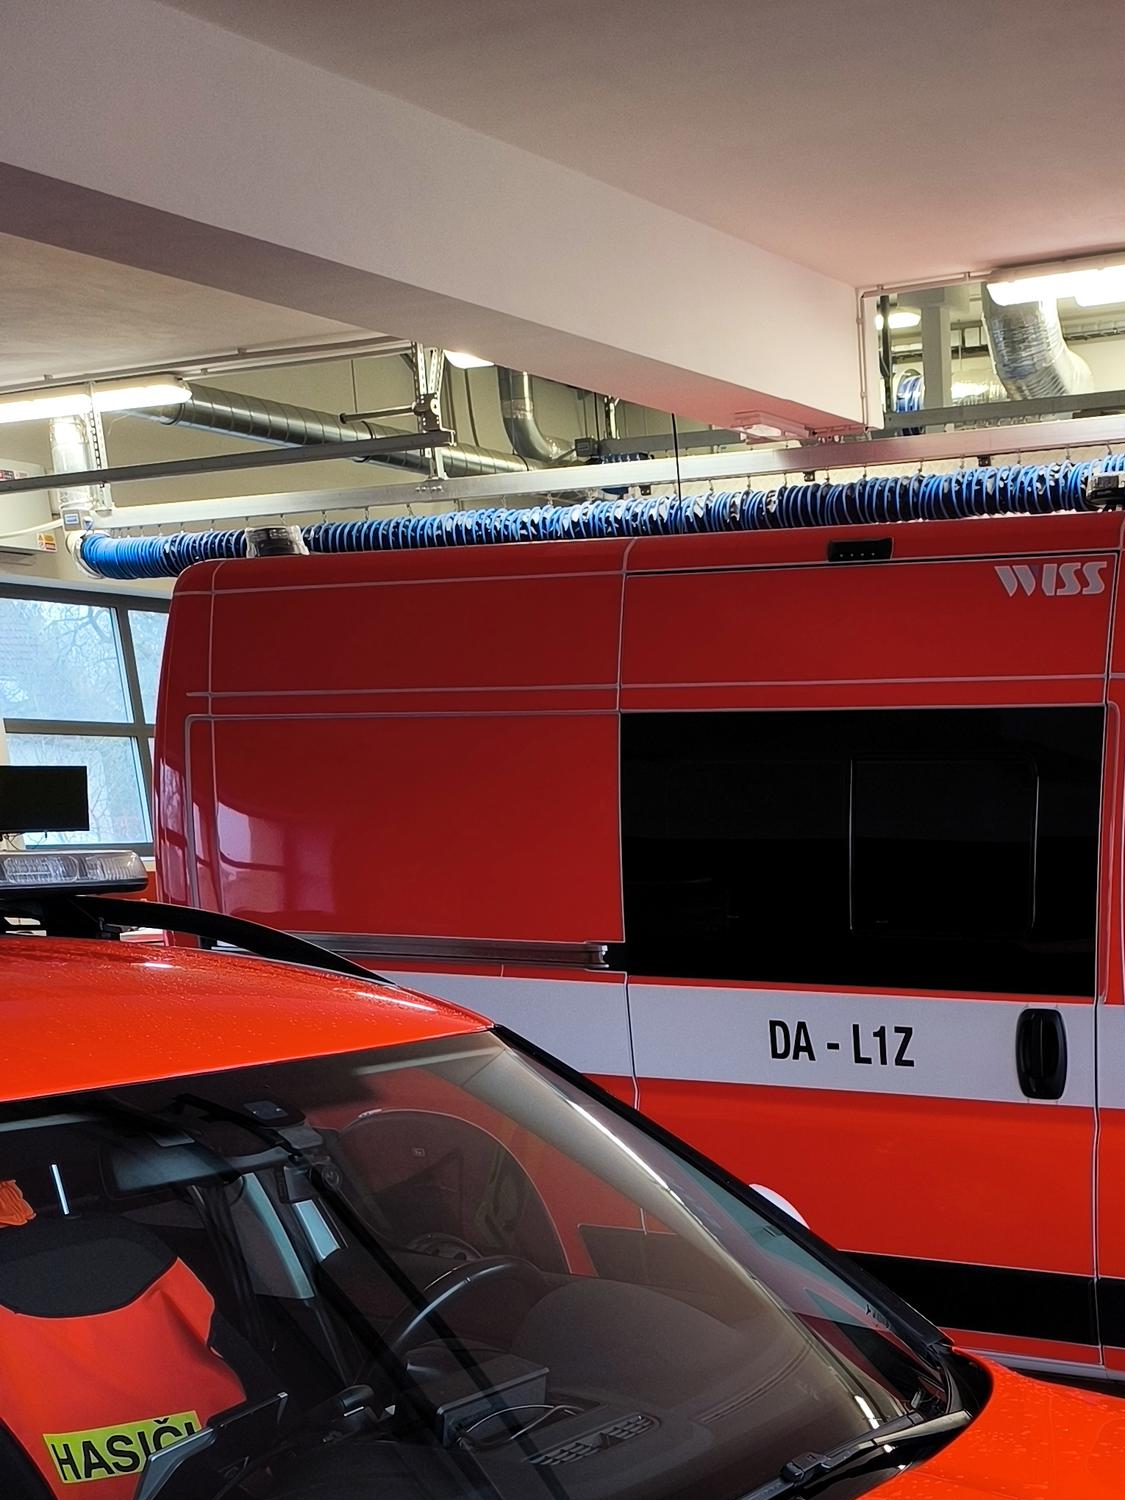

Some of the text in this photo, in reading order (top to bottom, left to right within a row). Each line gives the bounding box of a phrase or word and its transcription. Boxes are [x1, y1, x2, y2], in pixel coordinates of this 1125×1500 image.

[994, 561, 1107, 597] WISS
[769, 1020, 816, 1061] DA
[852, 1023, 915, 1067] L1Z
